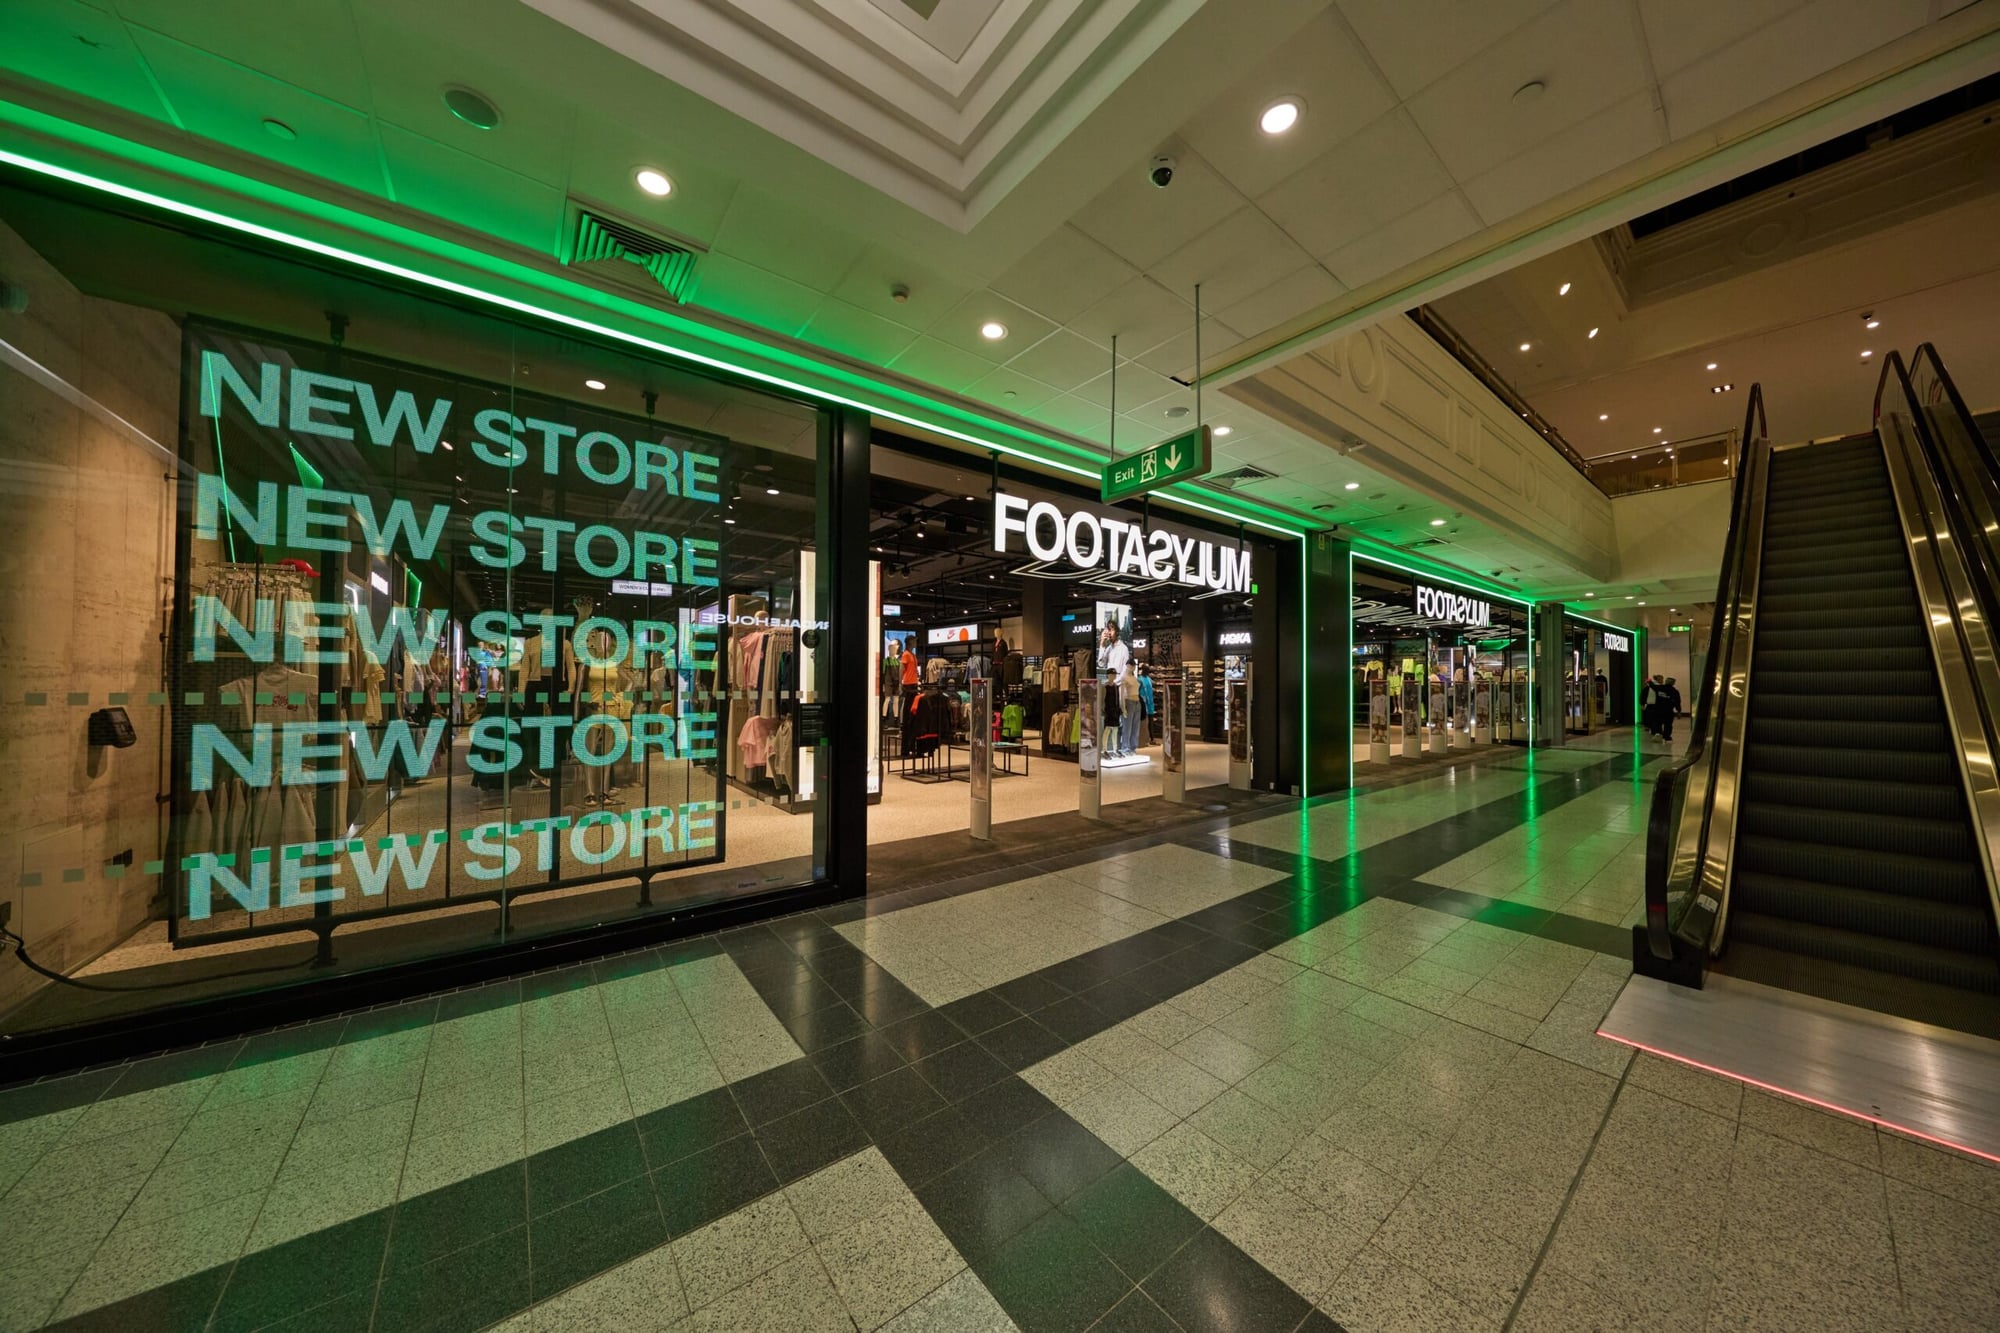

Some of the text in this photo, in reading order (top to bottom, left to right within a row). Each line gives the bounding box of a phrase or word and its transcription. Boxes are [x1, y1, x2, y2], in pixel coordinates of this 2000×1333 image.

[200, 350, 720, 503] NEW STORE
[1115, 467, 1134, 484] Exit
[197, 473, 720, 588] NEW STORE
[193, 595, 718, 672] NEW STORE
[1220, 632, 1251, 645] HOKA
[191, 711, 718, 791] NEW STORE
[188, 801, 717, 921] NEW STORE
